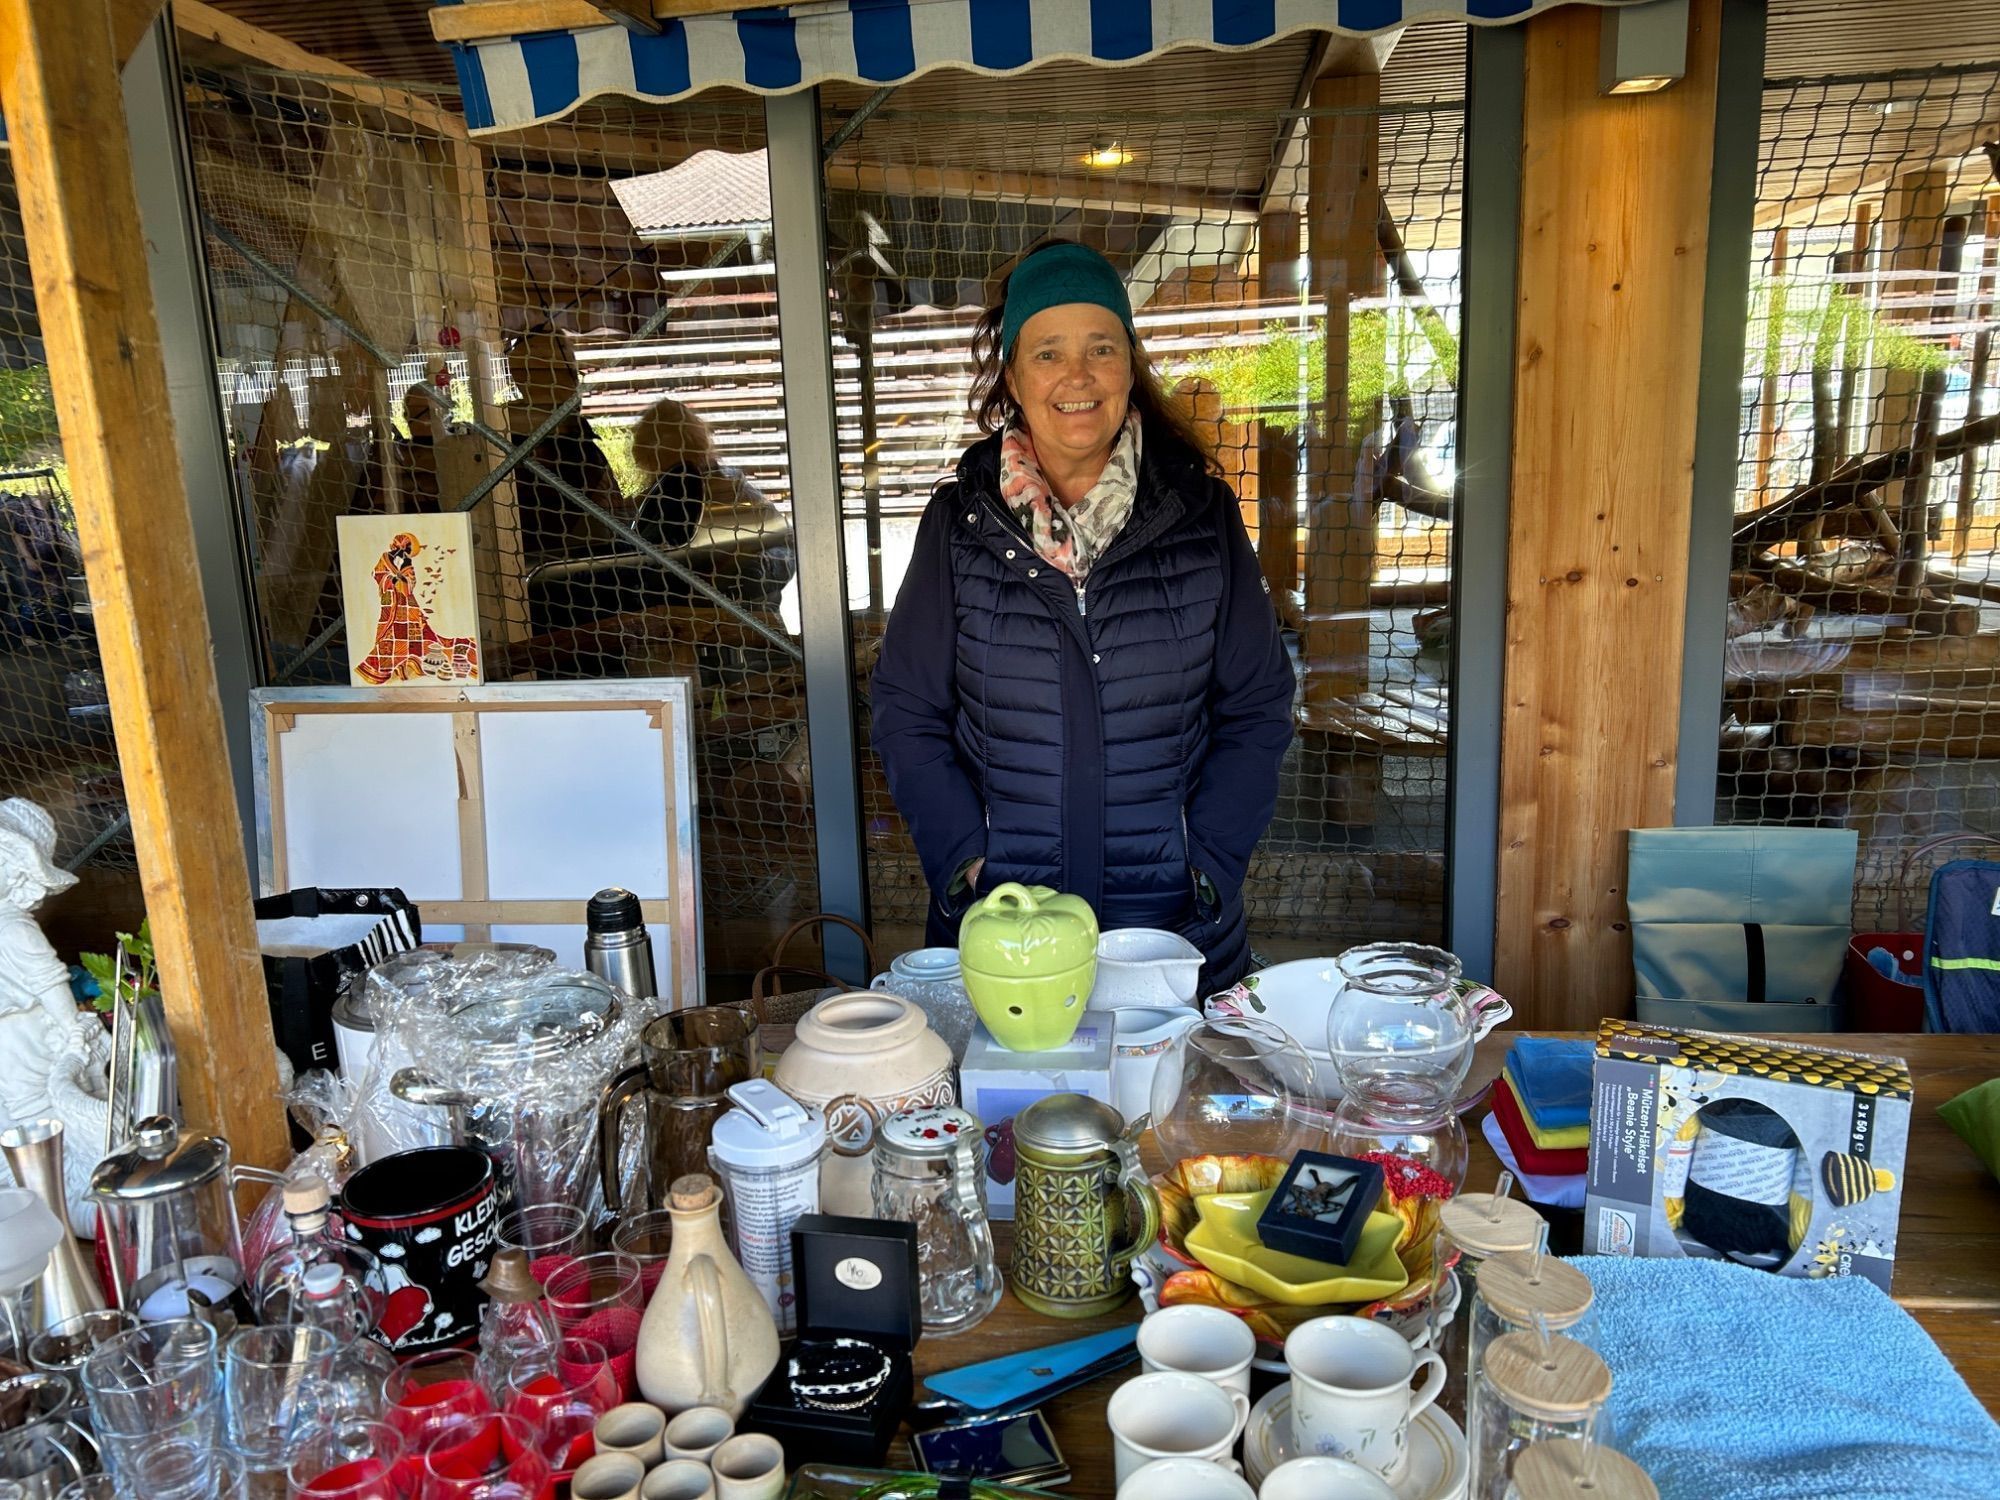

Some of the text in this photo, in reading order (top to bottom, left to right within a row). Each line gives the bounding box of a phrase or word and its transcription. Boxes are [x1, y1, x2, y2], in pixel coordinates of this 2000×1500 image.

[311, 1041, 328, 1061] E
[1637, 1088, 1653, 1174] Mützen-Häkelset
[1856, 1120, 1868, 1133] 50
[1852, 1133, 1865, 1141] g
